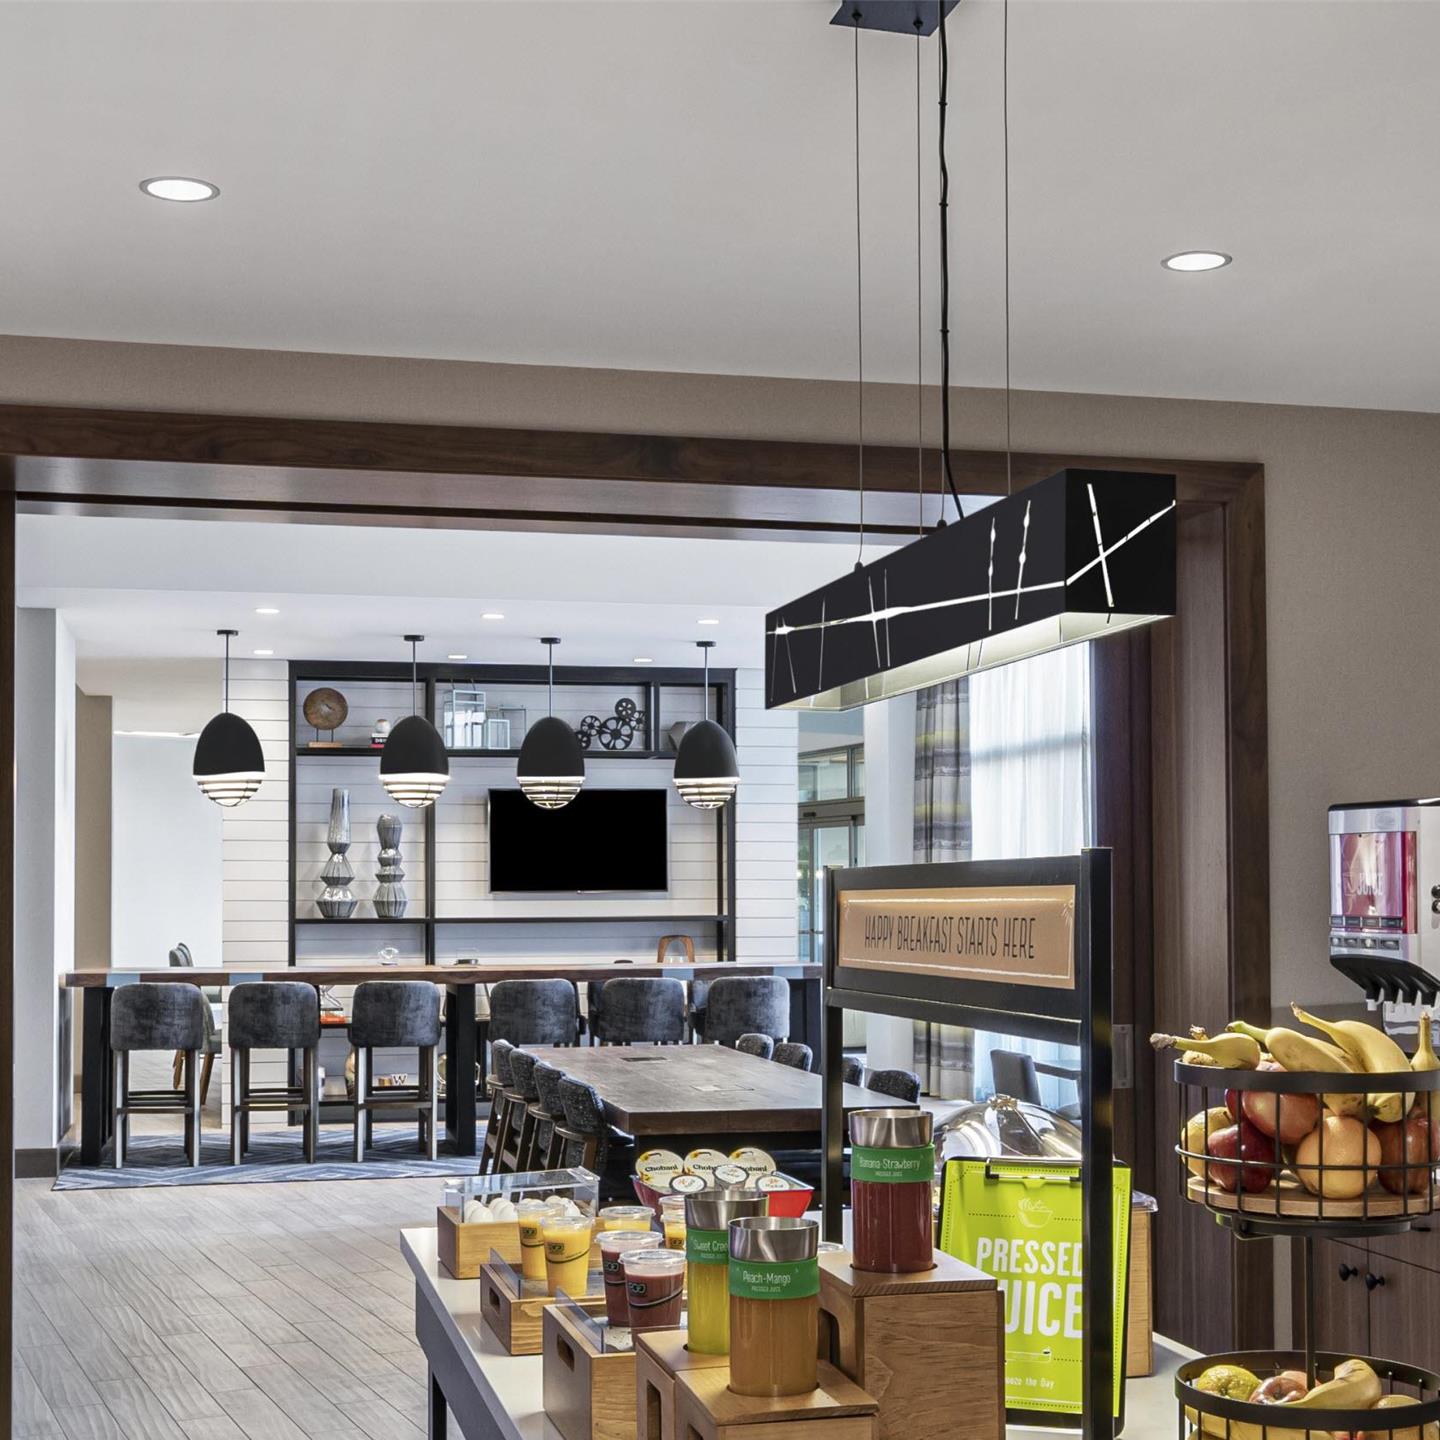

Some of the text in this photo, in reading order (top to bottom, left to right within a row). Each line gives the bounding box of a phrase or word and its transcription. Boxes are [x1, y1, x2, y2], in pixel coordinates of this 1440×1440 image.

[864, 915, 1037, 960] HAPPY BREAKFAST STARTS HERE
[644, 1164, 679, 1173] Chobani
[975, 1237, 1082, 1277] PRESSED
[742, 1270, 791, 1286] Peach-Mango
[1001, 1279, 1082, 1338] UICE
